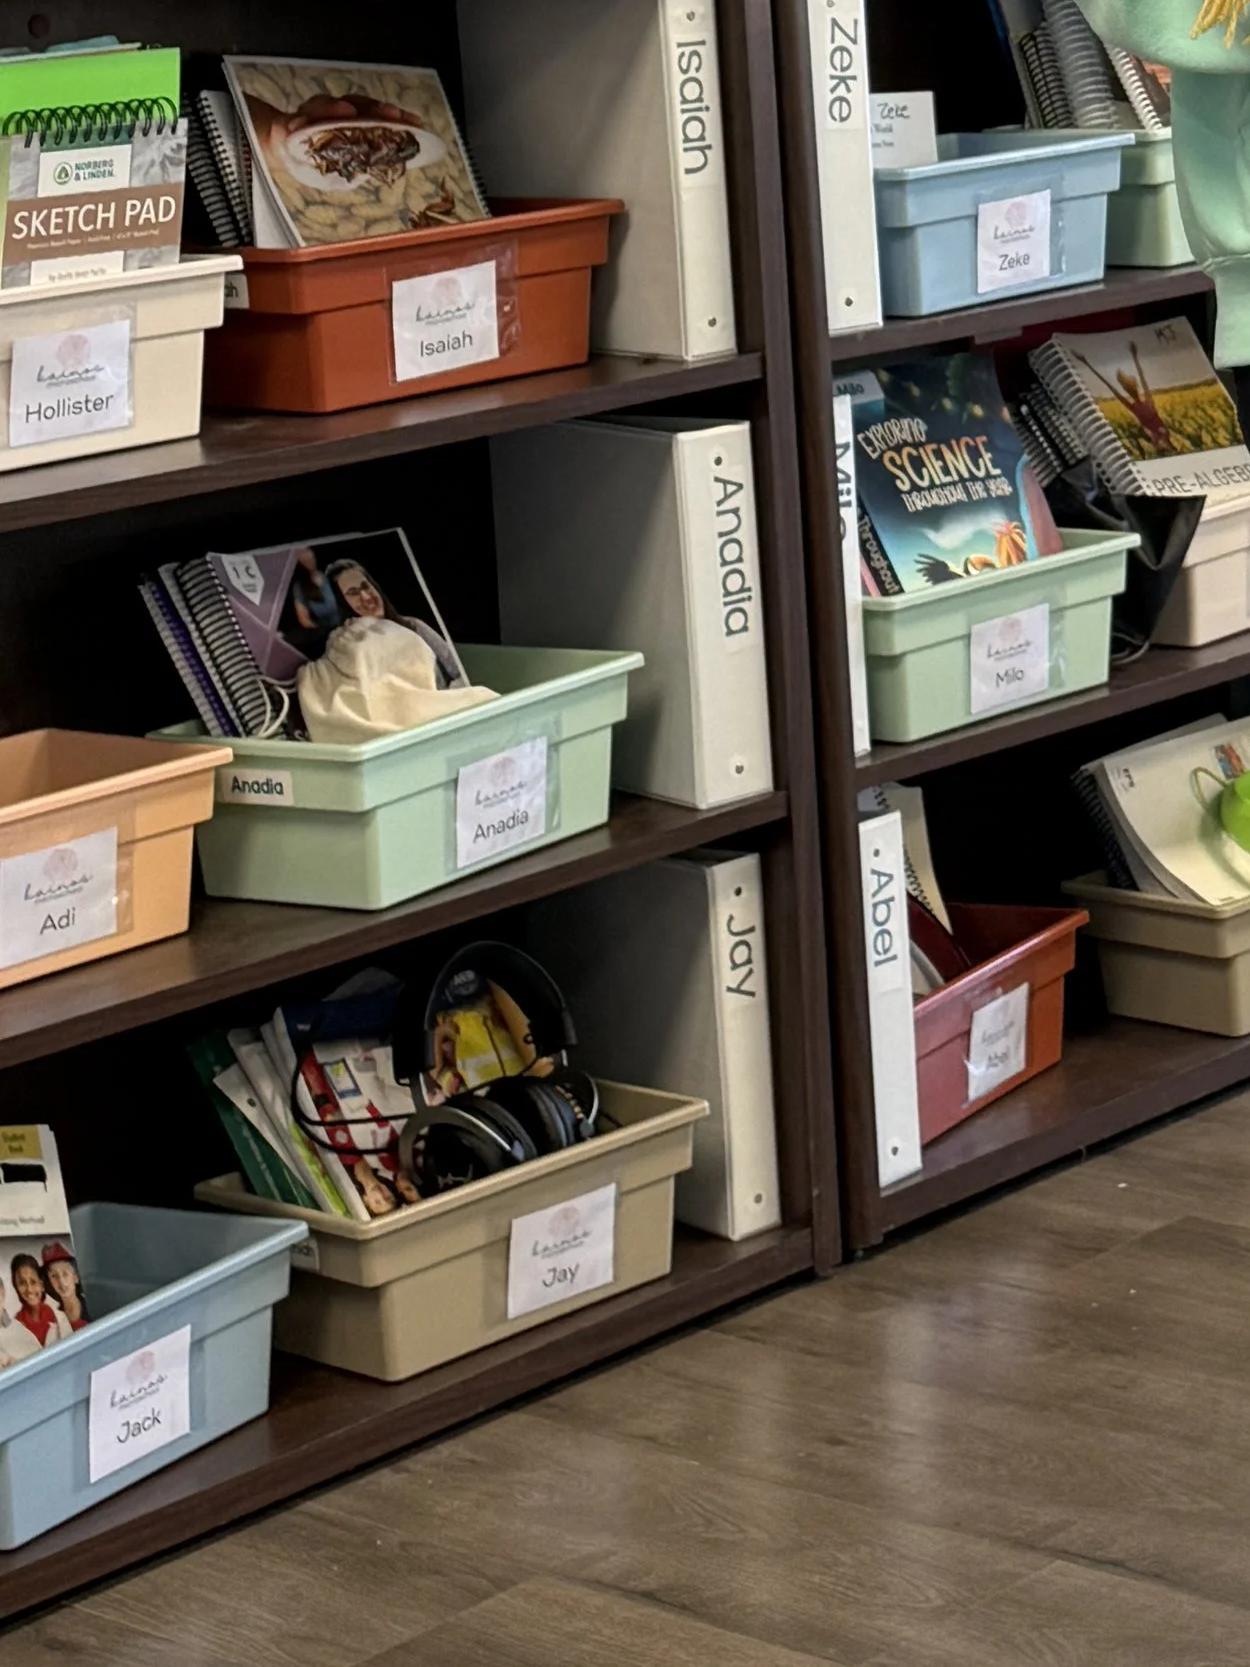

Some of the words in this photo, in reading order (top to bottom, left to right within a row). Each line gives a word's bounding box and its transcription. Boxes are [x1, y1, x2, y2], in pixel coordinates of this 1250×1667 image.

[828, 17, 859, 123] Zeke
[676, 39, 713, 175] Isaiah
[11, 201, 116, 240] SKETCH
[124, 195, 177, 227] PAD
[998, 252, 1031, 272] Zeke
[420, 329, 474, 358] Isaiah
[25, 394, 115, 424] Hollister
[857, 417, 928, 460] EXPLORING
[883, 435, 1002, 492] SCIENCE
[901, 483, 967, 513] THROUGHOUT
[967, 481, 988, 501] THE
[713, 475, 753, 638] Anadia
[996, 667, 1025, 688] Milo
[231, 775, 284, 796] Anadia
[473, 808, 529, 844] Anadia
[40, 906, 76, 935] Adi
[869, 867, 898, 968] Abel
[725, 913, 757, 998] Jay
[542, 1262, 580, 1288] Jay
[117, 1407, 162, 1444] Jack
